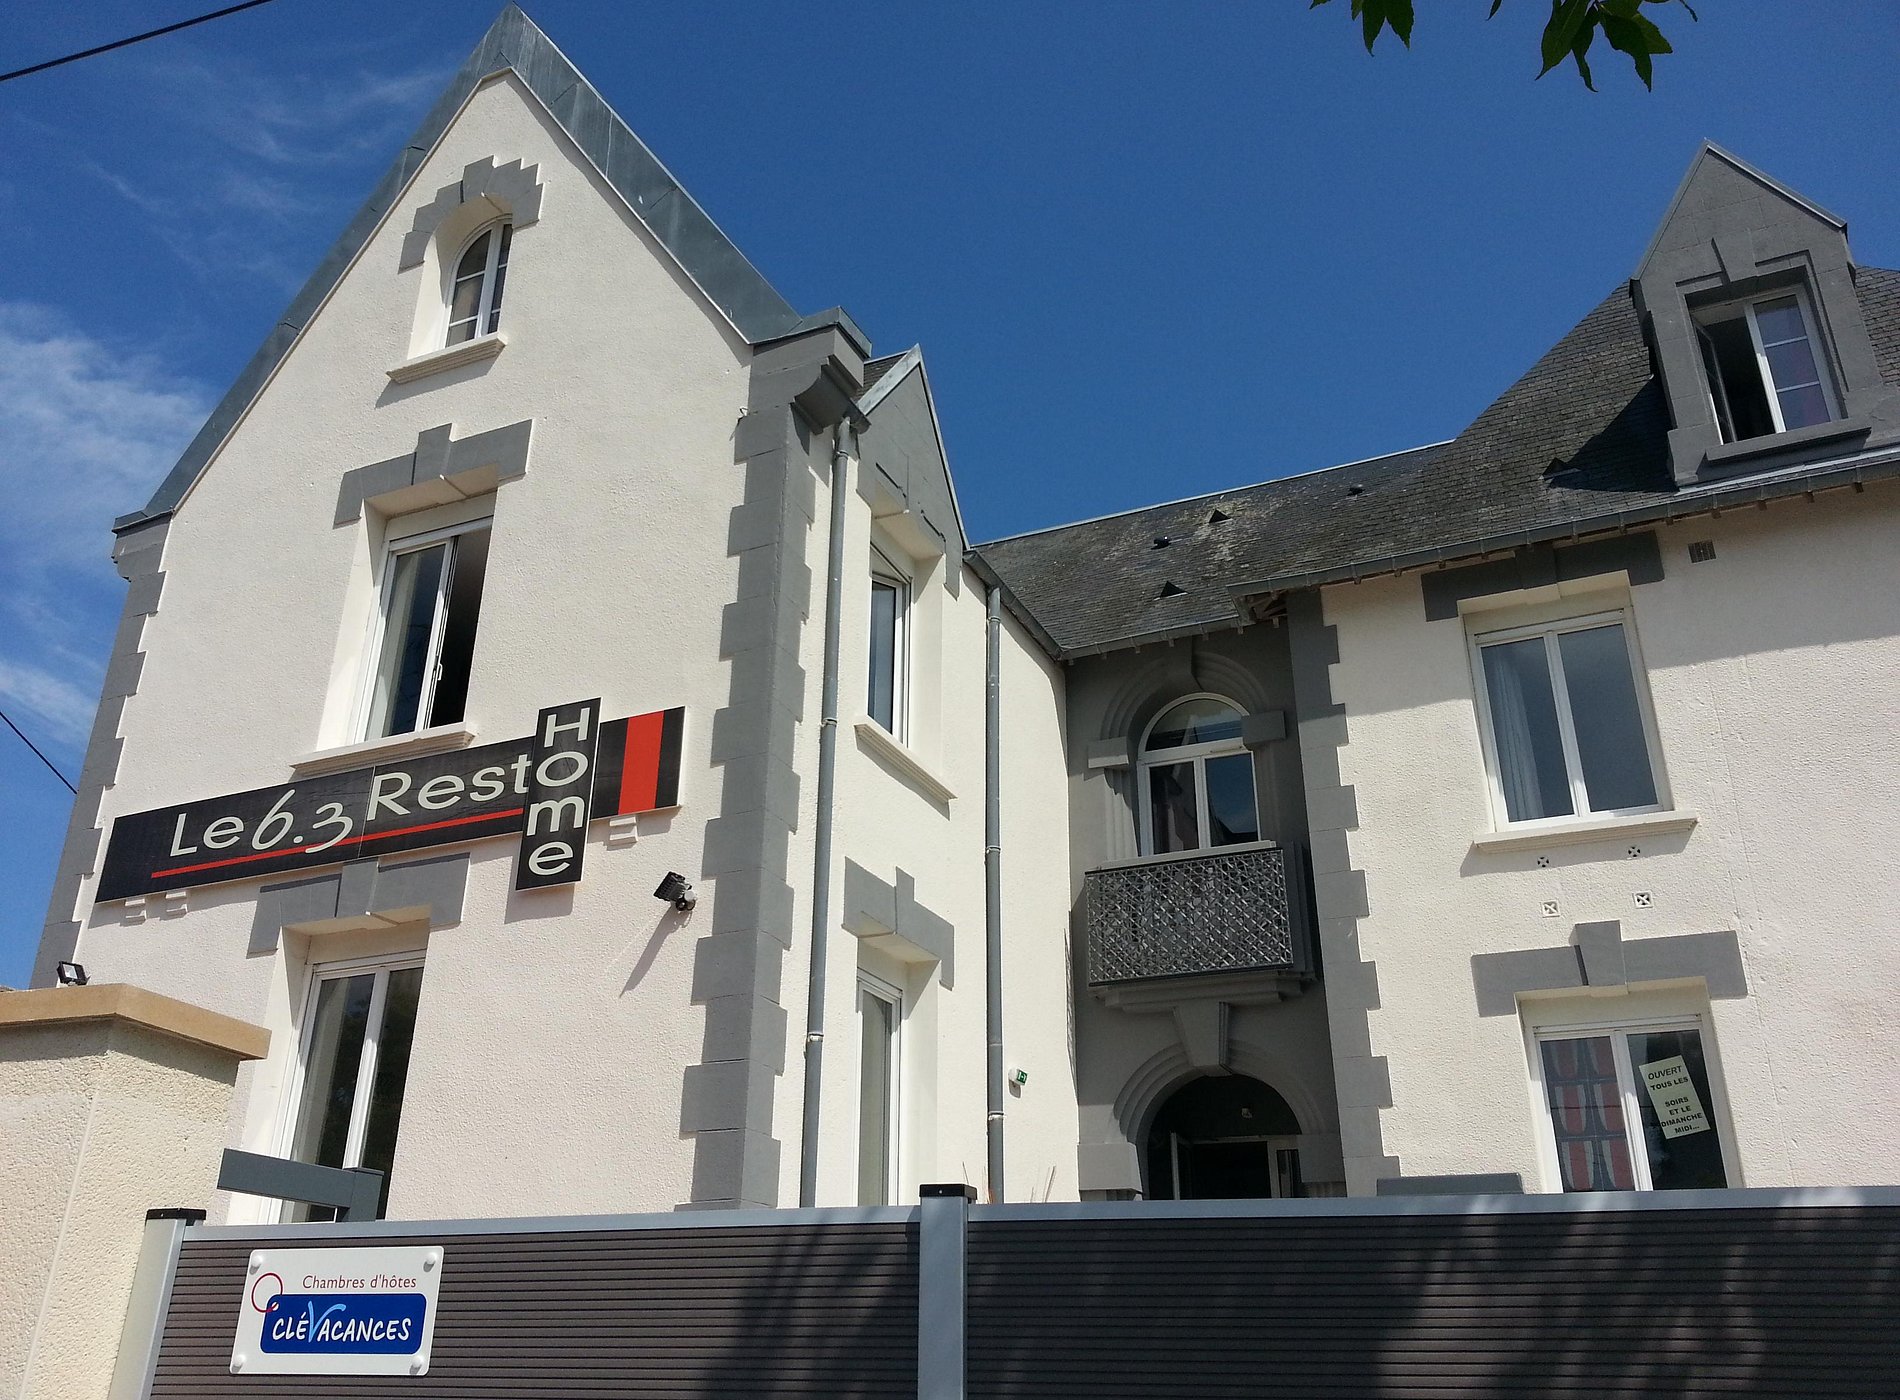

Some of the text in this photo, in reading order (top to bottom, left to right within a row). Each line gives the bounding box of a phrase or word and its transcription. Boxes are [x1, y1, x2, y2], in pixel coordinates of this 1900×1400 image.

[169, 813, 244, 857] Le
[252, 789, 354, 853] 6.3
[1648, 1066, 1682, 1080] OUVERT
[1650, 1076, 1689, 1091] TOUS LES
[1665, 1096, 1689, 1107] SOIRS
[1669, 1105, 1692, 1116] ET LE
[1661, 1112, 1703, 1127] DIMANCHE
[302, 1274, 416, 1289] Chambres d'hôtes
